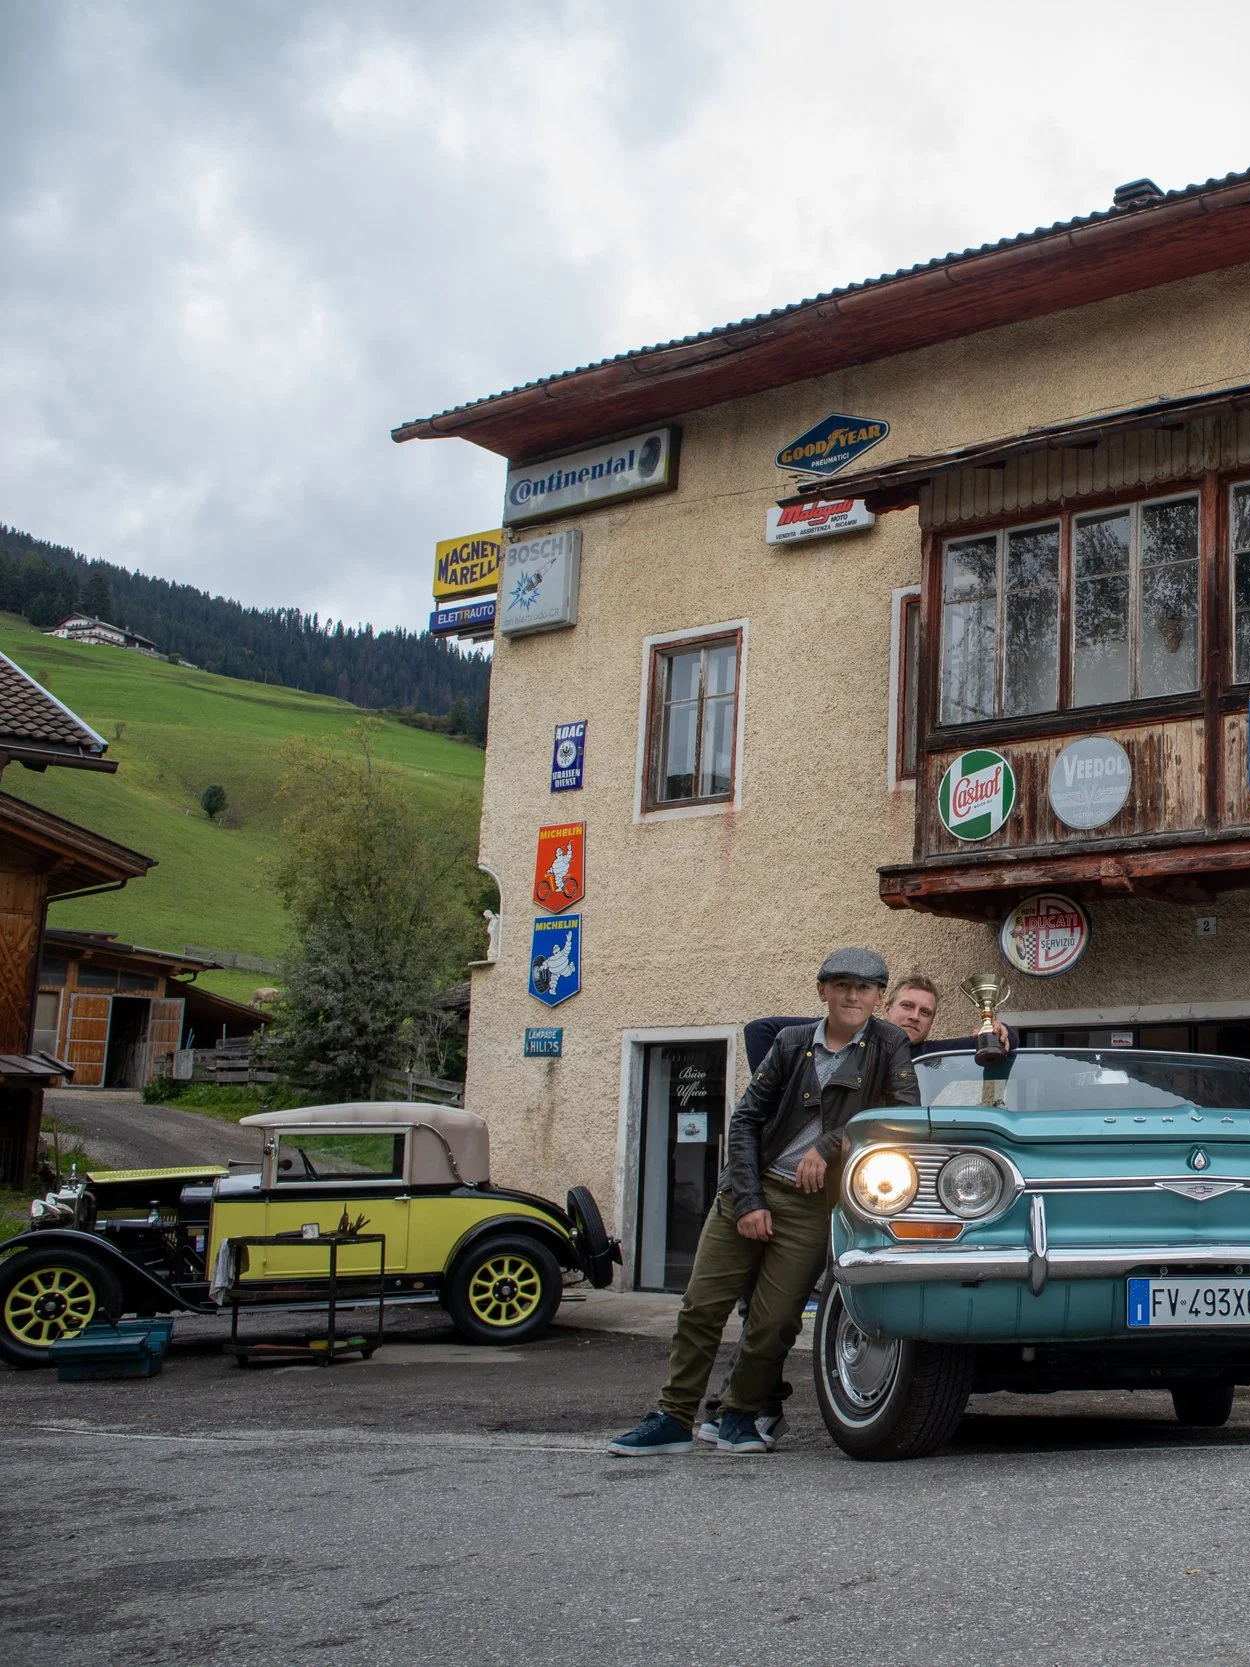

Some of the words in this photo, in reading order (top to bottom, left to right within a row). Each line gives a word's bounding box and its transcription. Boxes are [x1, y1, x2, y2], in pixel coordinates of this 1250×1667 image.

[811, 452, 849, 468] PNEUMATICI
[509, 449, 635, 506] Continental
[831, 514, 848, 523] MOTO
[776, 531, 797, 540] VENDITA
[800, 524, 832, 536] ASSISTENZA
[835, 519, 858, 529] RICAMBI
[507, 537, 564, 566] BOSCH
[438, 605, 495, 624] ELETTRAUTO
[556, 724, 584, 741] ADAC
[552, 768, 581, 780] STRASSEN
[1063, 754, 1126, 788] VEEDOL
[555, 777, 577, 788] DIENST
[952, 766, 1002, 818] Castrol
[540, 826, 583, 840] MICHELIN
[535, 919, 578, 931] MICHELIN
[1028, 914, 1078, 930] DUCATI
[1203, 920, 1210, 932] 2
[1041, 938, 1075, 949] SERVIZIO
[528, 1030, 557, 1040] LAMPADE
